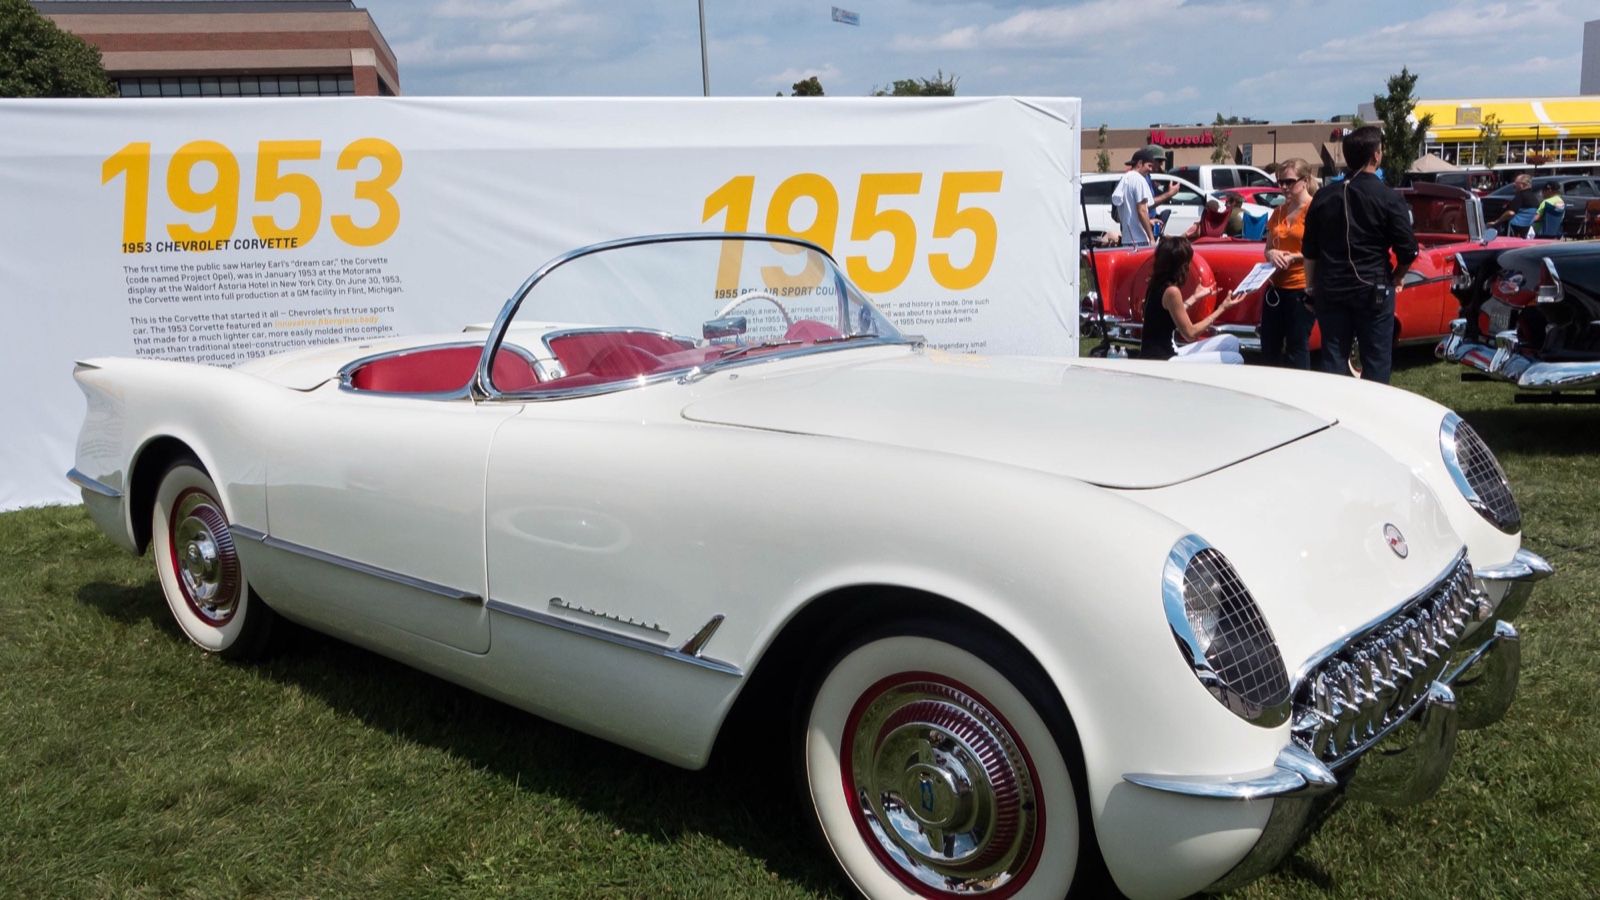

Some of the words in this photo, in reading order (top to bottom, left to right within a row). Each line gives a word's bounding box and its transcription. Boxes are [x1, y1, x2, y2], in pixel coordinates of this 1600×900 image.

[101, 137, 403, 254] 1953
[701, 170, 1004, 299] 1955
[122, 242, 152, 254] 1953
[156, 240, 231, 253] CHEVROLET
[234, 237, 298, 250] CORVETTE
[141, 265, 158, 273] first
[160, 264, 179, 272] time
[181, 263, 195, 271] the
[196, 262, 220, 272] public
[240, 261, 266, 270] Harley
[268, 260, 290, 268] Earl's
[355, 257, 388, 265] Corvette
[126, 275, 150, 285] (code
[151, 275, 179, 283] named
[181, 273, 210, 283] Project
[255, 271, 263, 279] in
[264, 270, 297, 279] January
[298, 269, 317, 277] 1953
[342, 267, 382, 275] Motorama
[127, 286, 157, 295] display
[169, 284, 183, 292] the
[184, 283, 216, 291] Waldorf
[218, 282, 247, 290] Astoria
[248, 281, 269, 289] Hotel
[270, 280, 278, 288] in
[280, 280, 297, 288] New
[299, 279, 316, 287] York
[348, 277, 367, 285] June
[715, 288, 738, 299] 1955
[781, 286, 813, 296] SPORT
[815, 286, 838, 296] COU
[128, 297, 142, 305] the
[144, 295, 179, 304] Corvette
[204, 293, 220, 301] into
[221, 292, 235, 300] full
[236, 291, 279, 301] production
[297, 289, 309, 297] GM
[310, 287, 337, 297] facility
[338, 287, 346, 295] in
[912, 300, 933, 309] history
[130, 317, 148, 325] This
[149, 316, 157, 324] is
[158, 315, 172, 323] the
[174, 314, 209, 322] Corvette
[230, 311, 260, 320] started
[269, 310, 279, 318] all
[288, 308, 332, 318] Chevrolet's
[333, 307, 350, 315] first
[352, 306, 368, 314] true
[369, 306, 395, 315] sports
[133, 337, 151, 345] that
[153, 336, 176, 344] made
[178, 335, 190, 343] for
[223, 332, 249, 341] lighter
[290, 329, 313, 339] easily
[314, 327, 343, 335] molded
[345, 326, 360, 334] into
[361, 325, 393, 335] complex
[150, 326, 166, 334] The
[168, 325, 187, 333] 1953
[189, 324, 224, 332] Corvette
[226, 322, 261, 330] featured
[135, 346, 166, 356] shapes
[167, 345, 187, 353] than
[188, 343, 231, 352] traditional
[197, 352, 235, 364] produced
[237, 351, 245, 359] in
